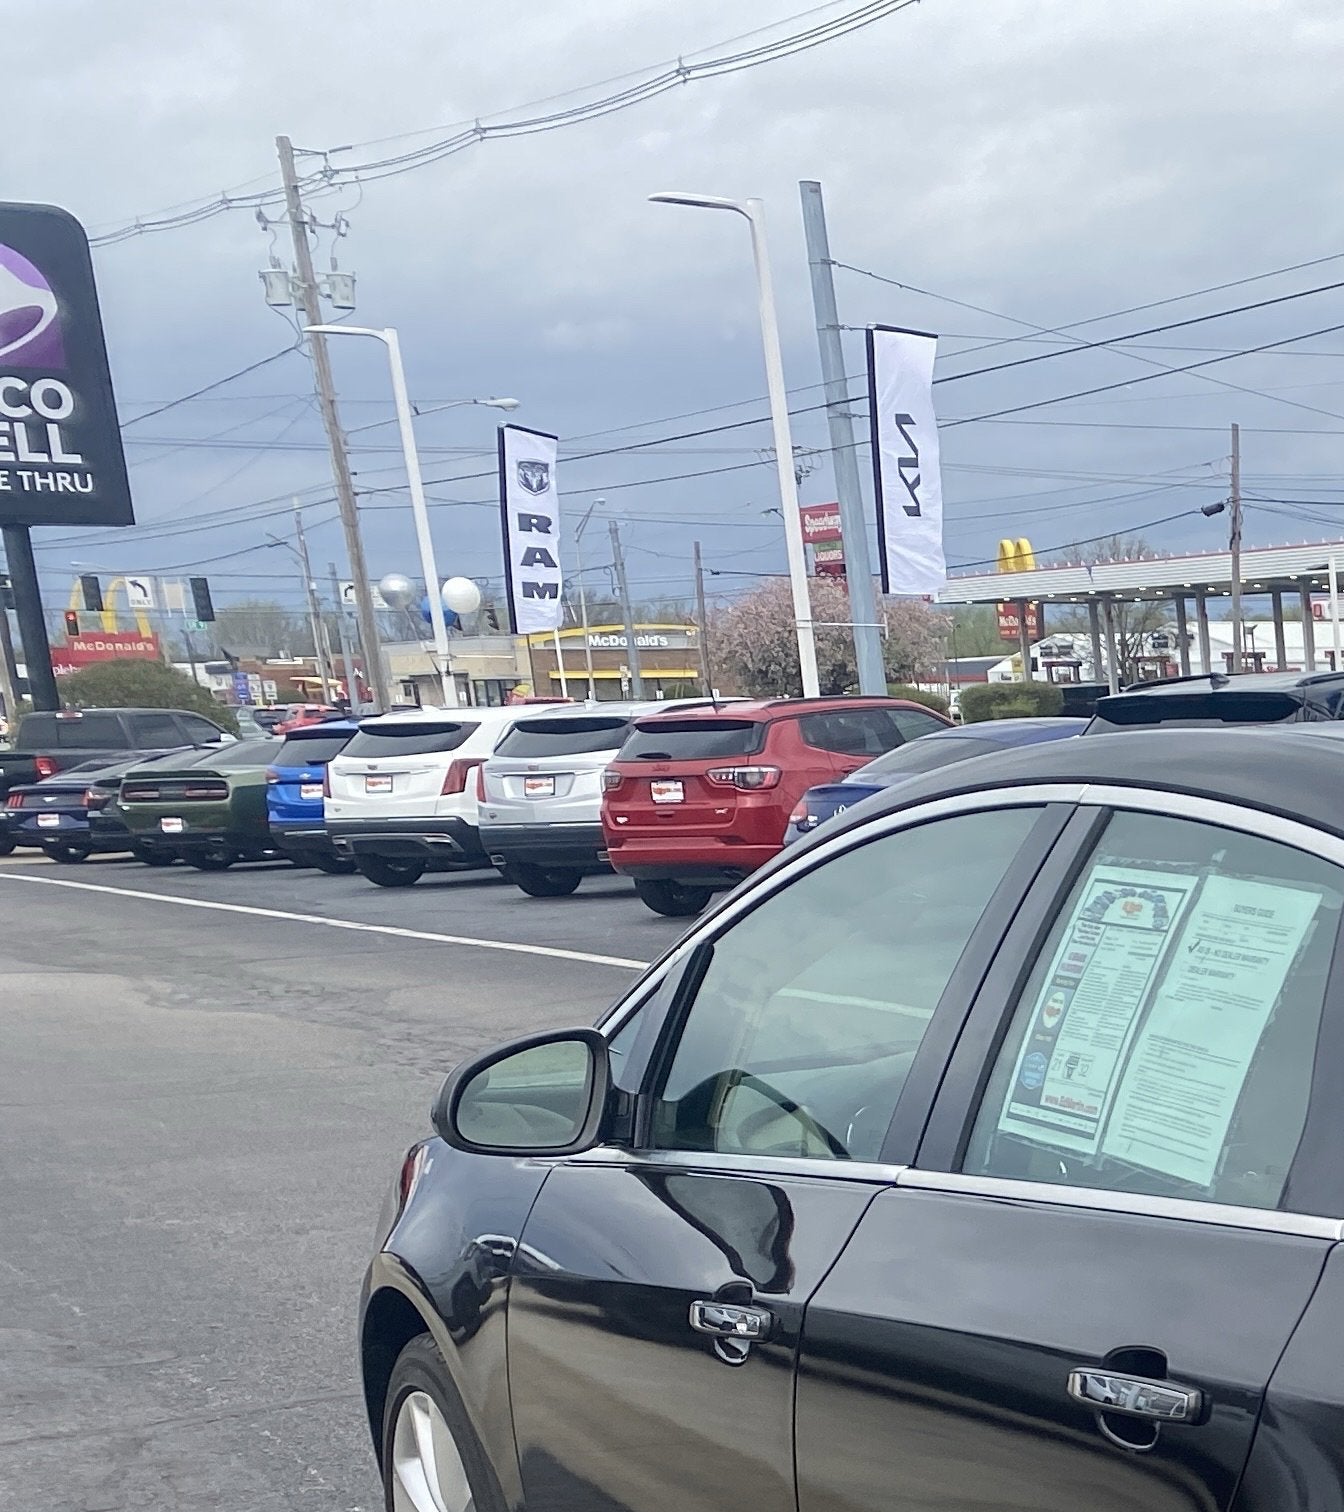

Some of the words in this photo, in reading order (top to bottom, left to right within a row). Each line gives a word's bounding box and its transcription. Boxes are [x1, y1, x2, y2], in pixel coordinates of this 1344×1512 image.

[0, 376, 74, 420] CO
[16, 470, 94, 493] THRU
[895, 413, 921, 517] KIA
[517, 513, 559, 600] RAM
[589, 634, 668, 647] McDoald's
